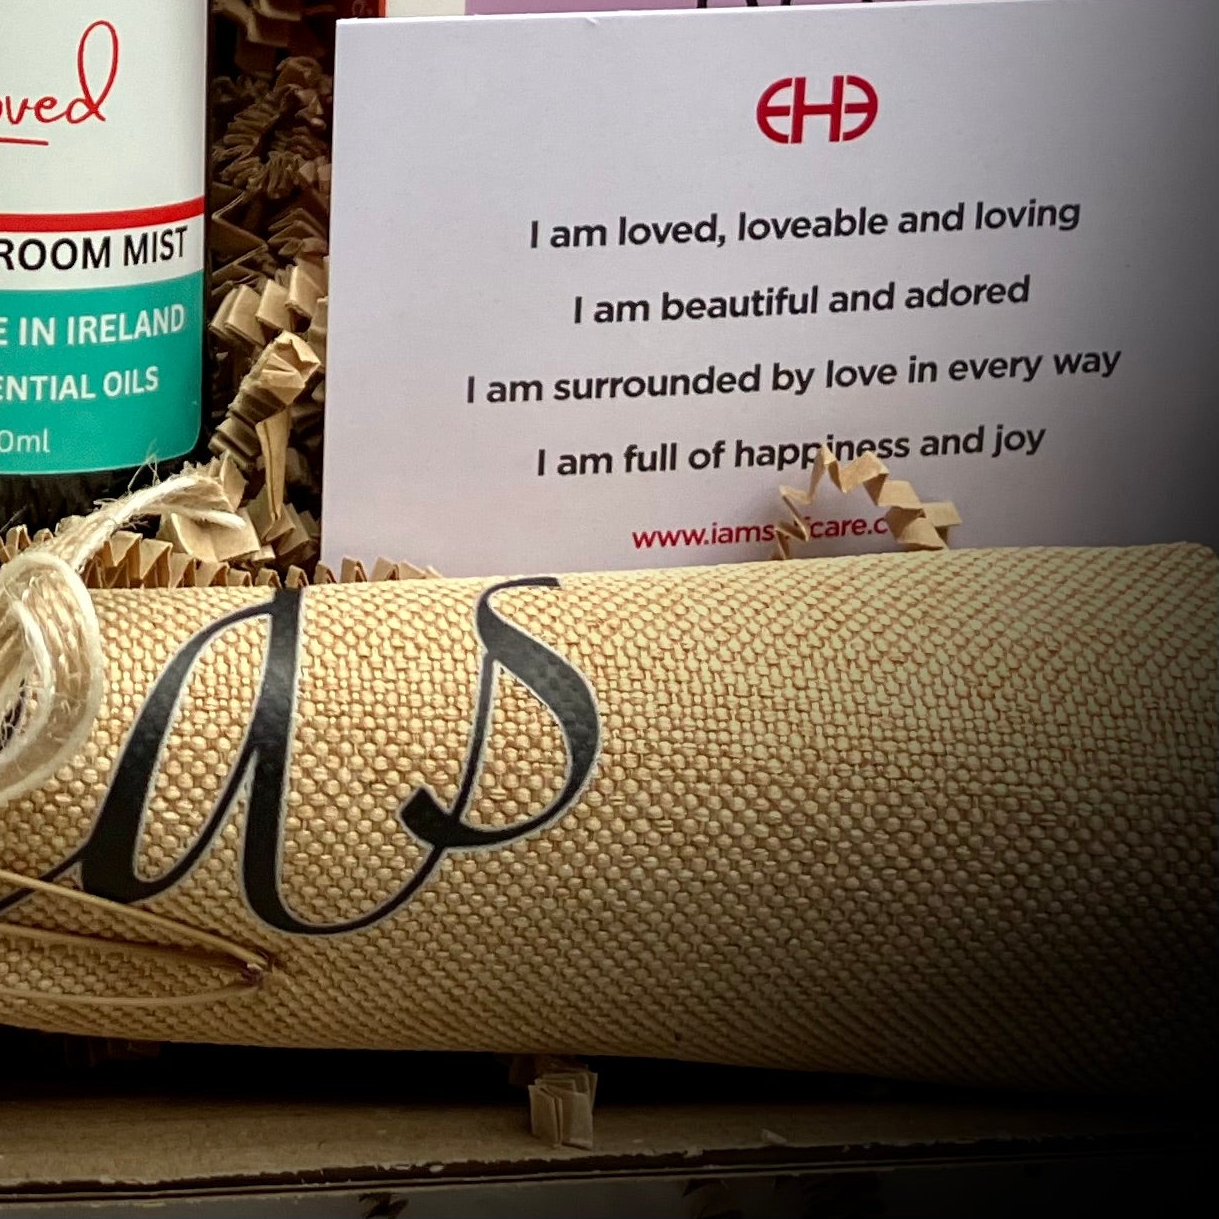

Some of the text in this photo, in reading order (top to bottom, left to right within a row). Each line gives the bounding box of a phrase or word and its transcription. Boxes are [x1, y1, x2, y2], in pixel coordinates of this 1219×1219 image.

[123, 225, 188, 266] MIST
[530, 198, 1081, 249] I am loved, loveable and loving
[574, 274, 1031, 324] I am beautiful and adored
[19, 316, 56, 346] IN
[67, 303, 186, 346] IRELAND
[103, 366, 159, 396] OILS
[467, 347, 1122, 404] I am surrounded by love in every way
[537, 448, 546, 477] I
[557, 452, 613, 476] am
[623, 442, 677, 473] full
[688, 440, 726, 470] of
[919, 425, 985, 457] and
[991, 424, 1046, 458] joy
